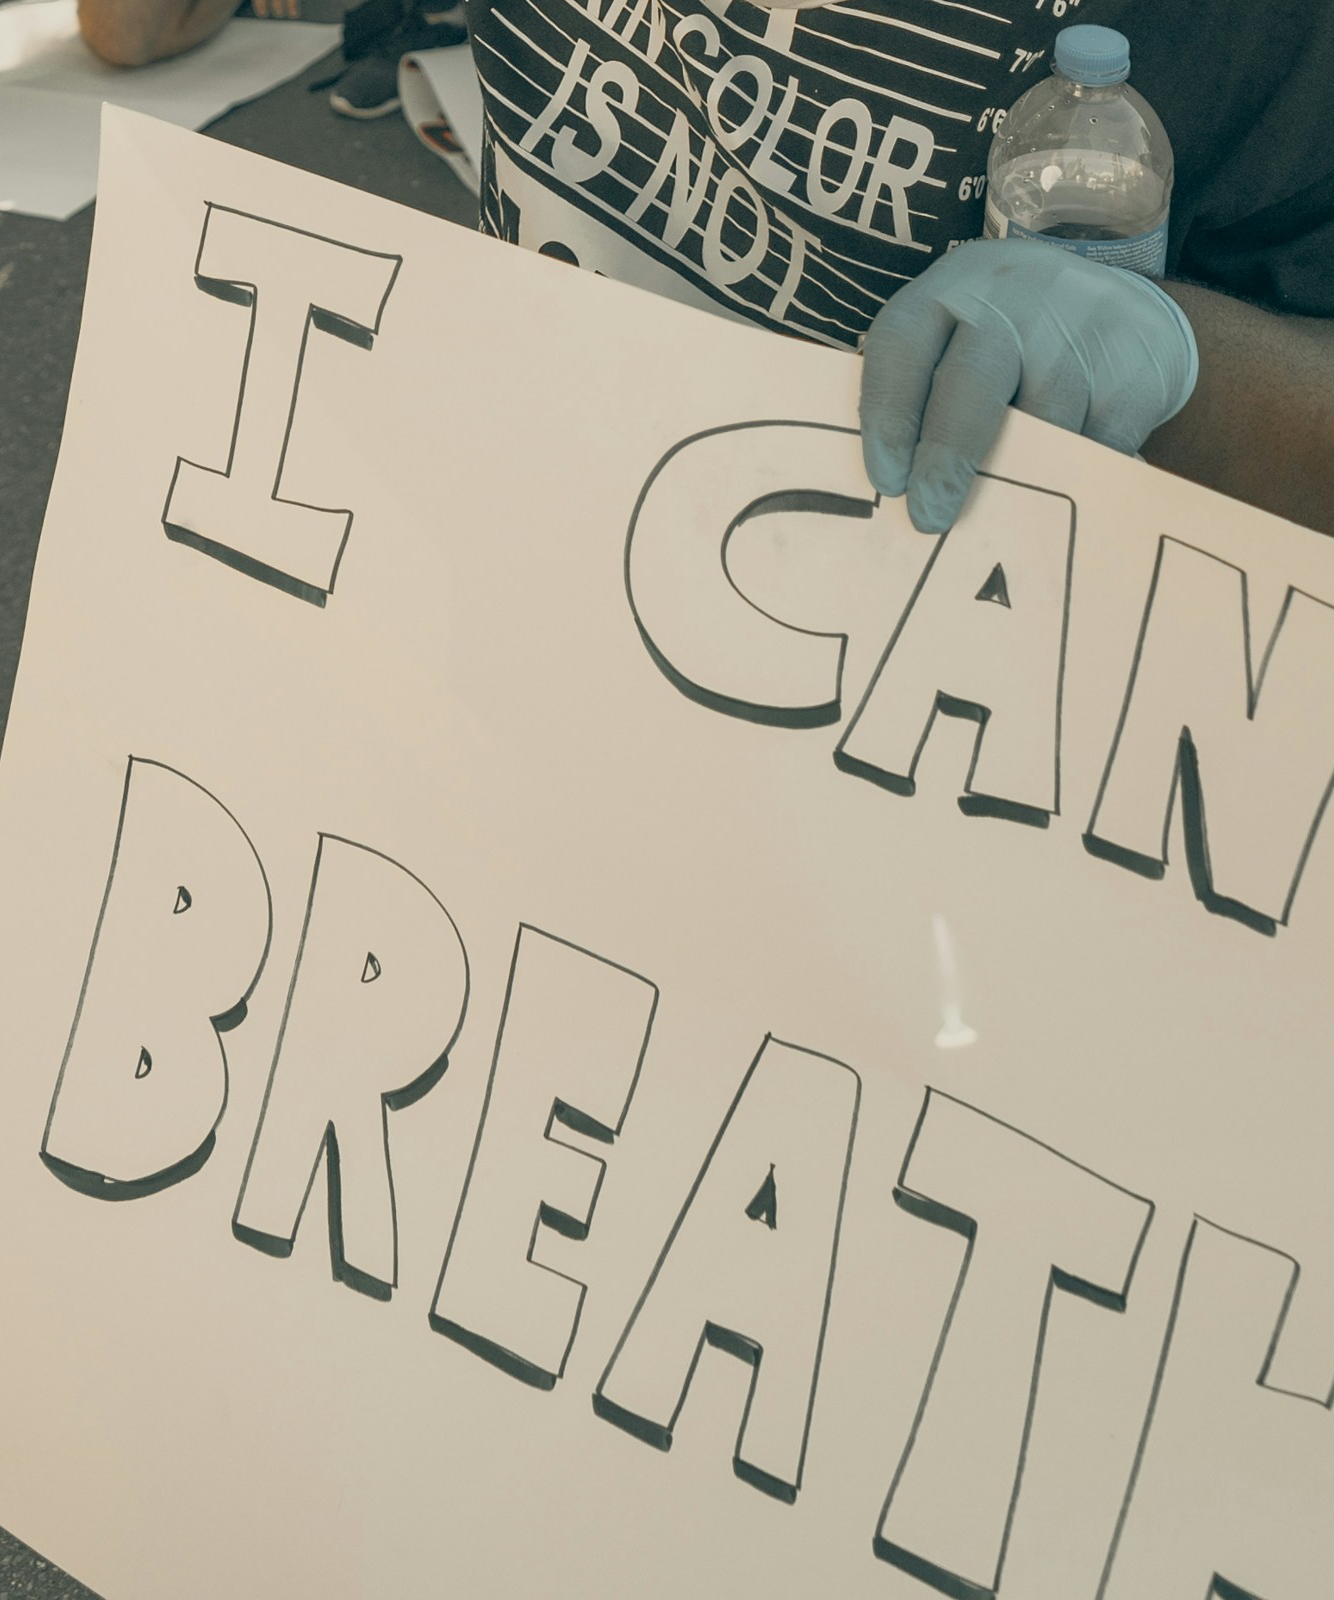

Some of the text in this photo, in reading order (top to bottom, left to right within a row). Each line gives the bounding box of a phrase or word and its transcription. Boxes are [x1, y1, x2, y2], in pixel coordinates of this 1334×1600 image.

[519, 37, 639, 184] IS
[625, 108, 823, 321] NOT
[672, 13, 935, 243] COLOR
[958, 174, 989, 202] 6'0
[977, 106, 1008, 135] 6'6
[159, 203, 402, 609] I
